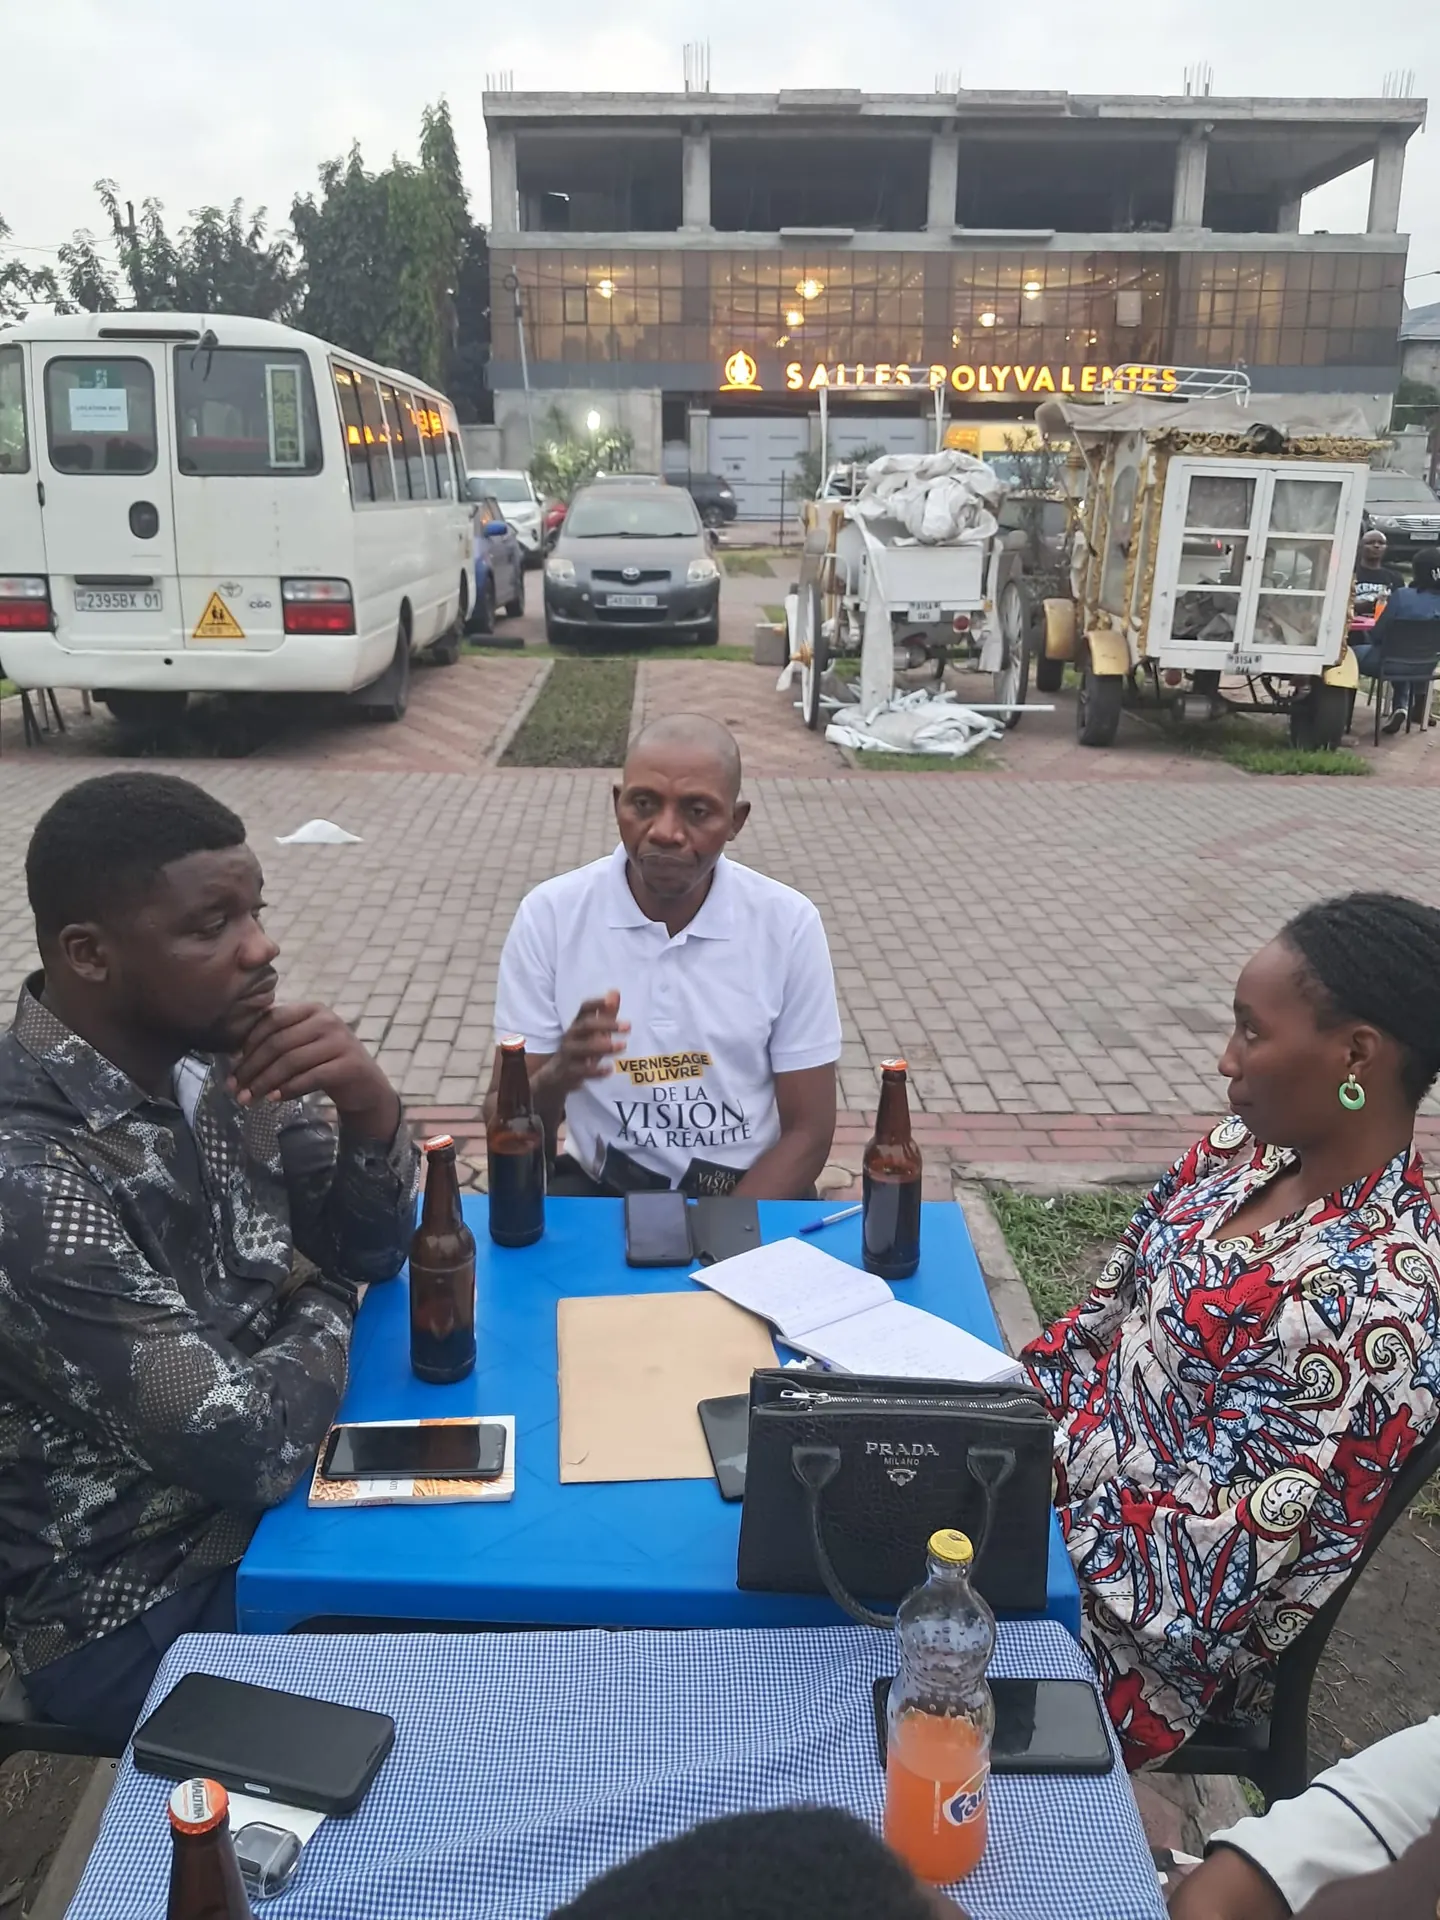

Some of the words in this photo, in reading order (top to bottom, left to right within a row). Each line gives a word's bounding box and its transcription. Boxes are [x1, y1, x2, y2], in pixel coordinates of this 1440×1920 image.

[786, 361, 912, 391] SALLES
[928, 363, 1178, 393] POLYVALENTES
[618, 1053, 710, 1071] VERNISSAGE
[634, 1071, 655, 1083] DU
[658, 1065, 700, 1080] LIVRE
[652, 1086, 677, 1102] DE
[684, 1085, 708, 1101] LA
[613, 1099, 745, 1130] VISION
[632, 1130, 659, 1148] LA
[865, 1441, 940, 1457] PRADA
[883, 1457, 920, 1466] MILANO
